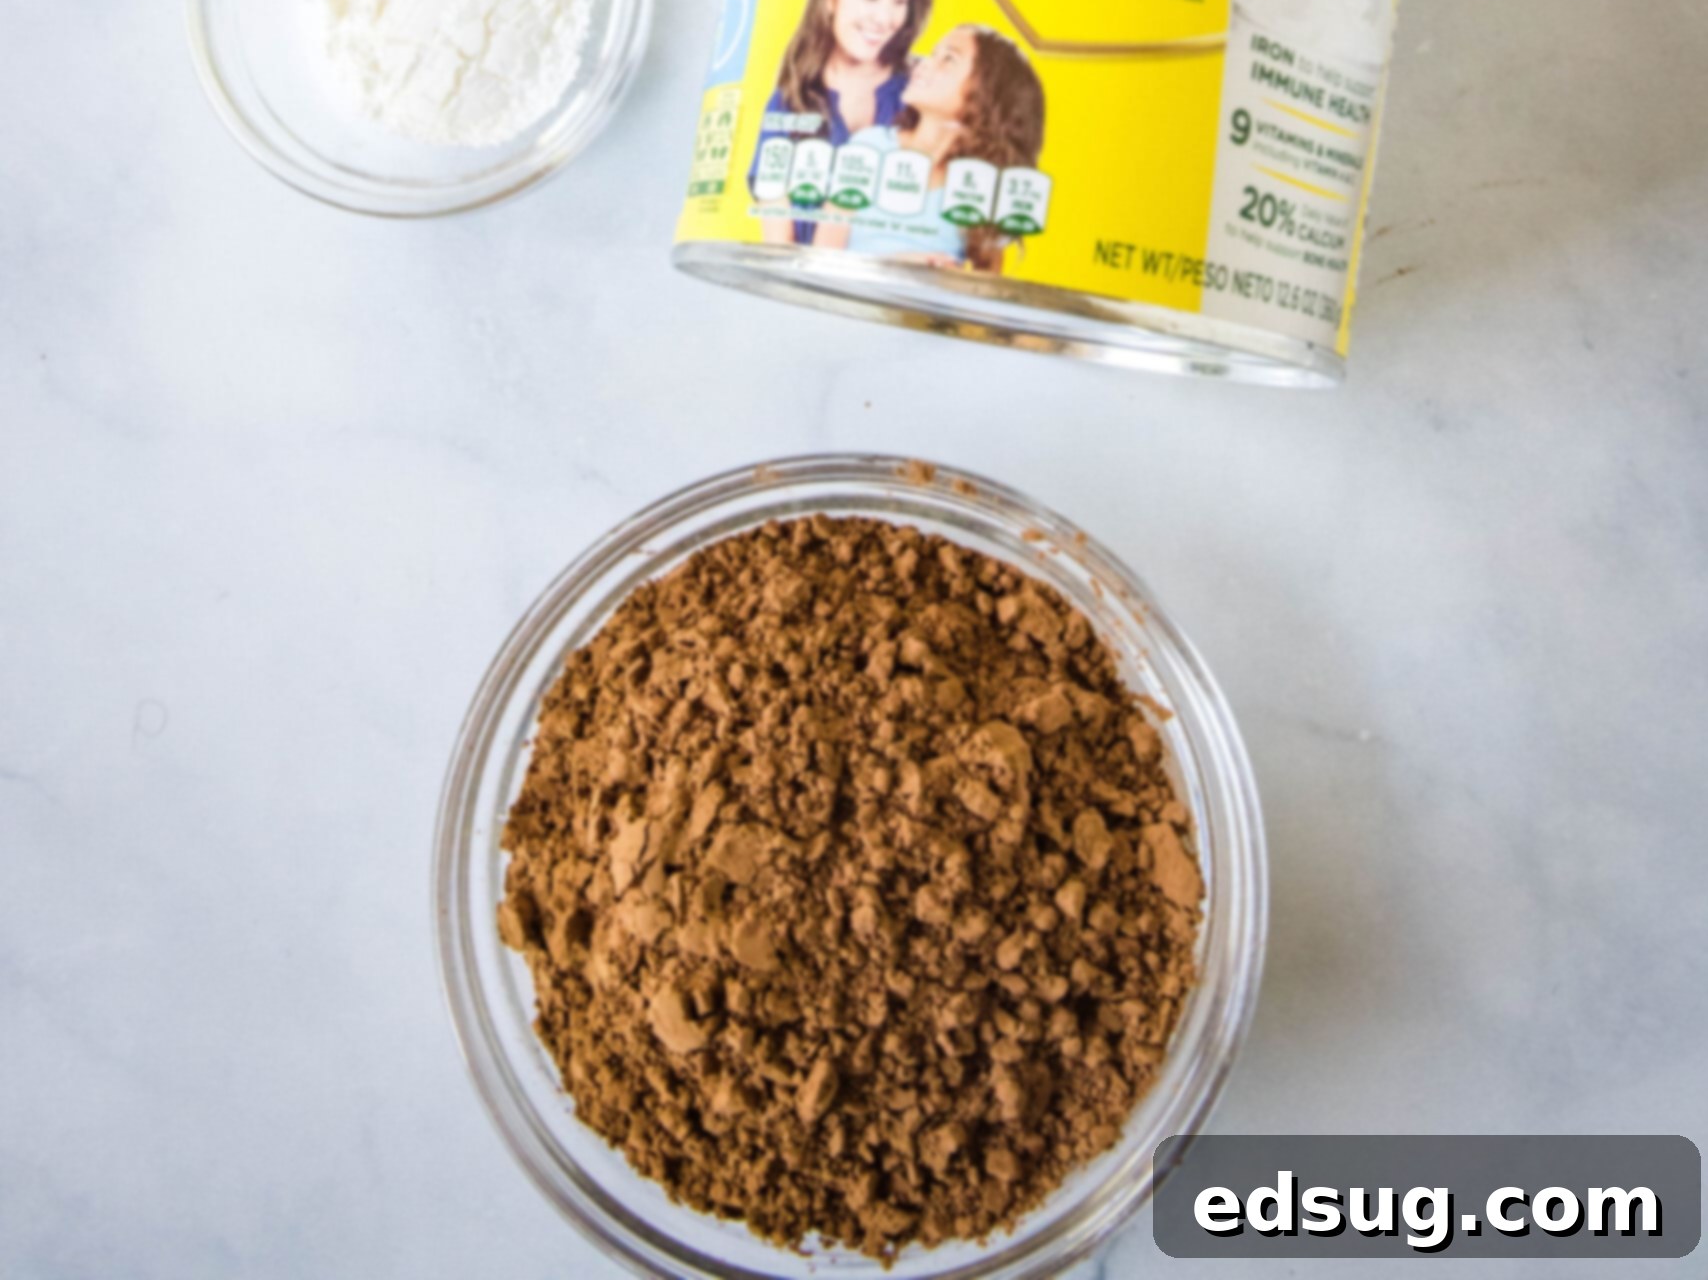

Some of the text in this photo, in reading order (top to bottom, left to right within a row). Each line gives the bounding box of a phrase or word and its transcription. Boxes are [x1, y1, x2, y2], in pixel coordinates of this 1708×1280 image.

[1251, 34, 1295, 66] IRON
[1251, 61, 1325, 109] IMMUNE
[1230, 108, 1252, 146] 9
[1256, 120, 1315, 154] VITAMINS
[1238, 183, 1296, 237] 20%
[1093, 239, 1137, 270] NET
[1141, 249, 1228, 292] WT/PESO
[1231, 271, 1273, 304] NETO
